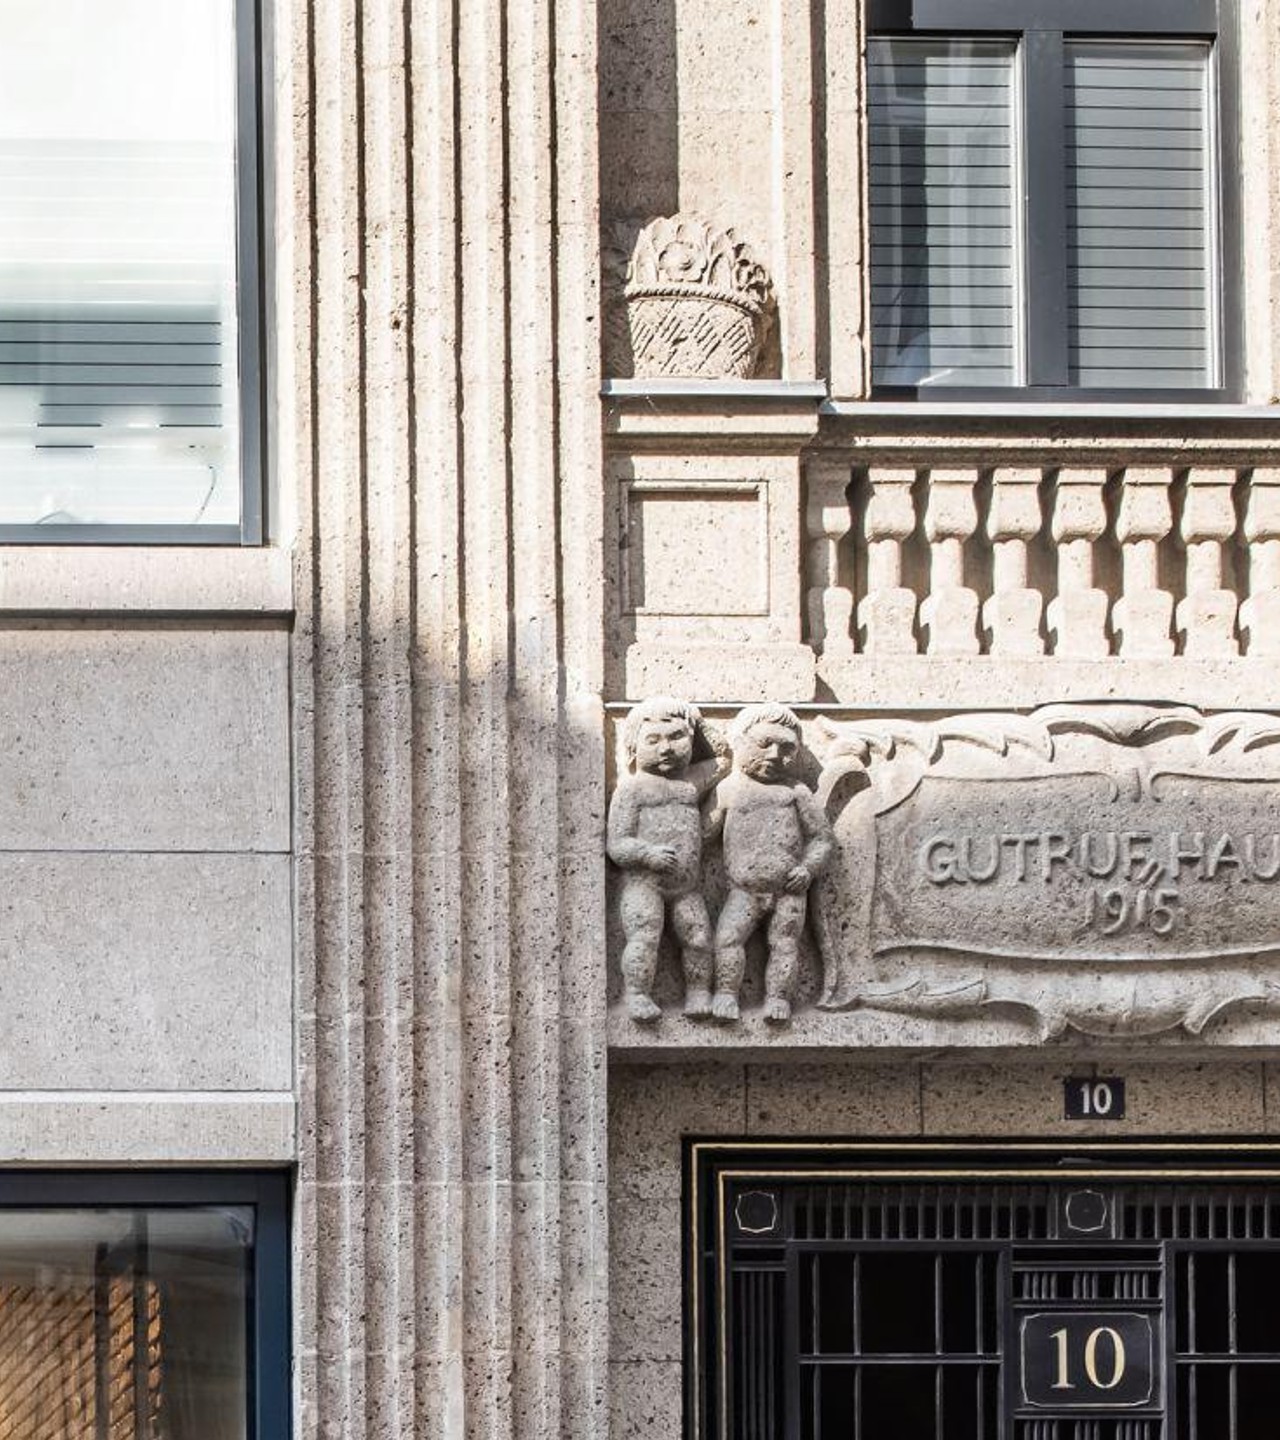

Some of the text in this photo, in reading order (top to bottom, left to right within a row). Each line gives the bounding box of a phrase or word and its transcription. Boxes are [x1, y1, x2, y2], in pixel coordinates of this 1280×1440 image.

[1078, 889, 1180, 936] 1915
[1080, 1082, 1113, 1115] 10
[1048, 1326, 1126, 1389] 10
